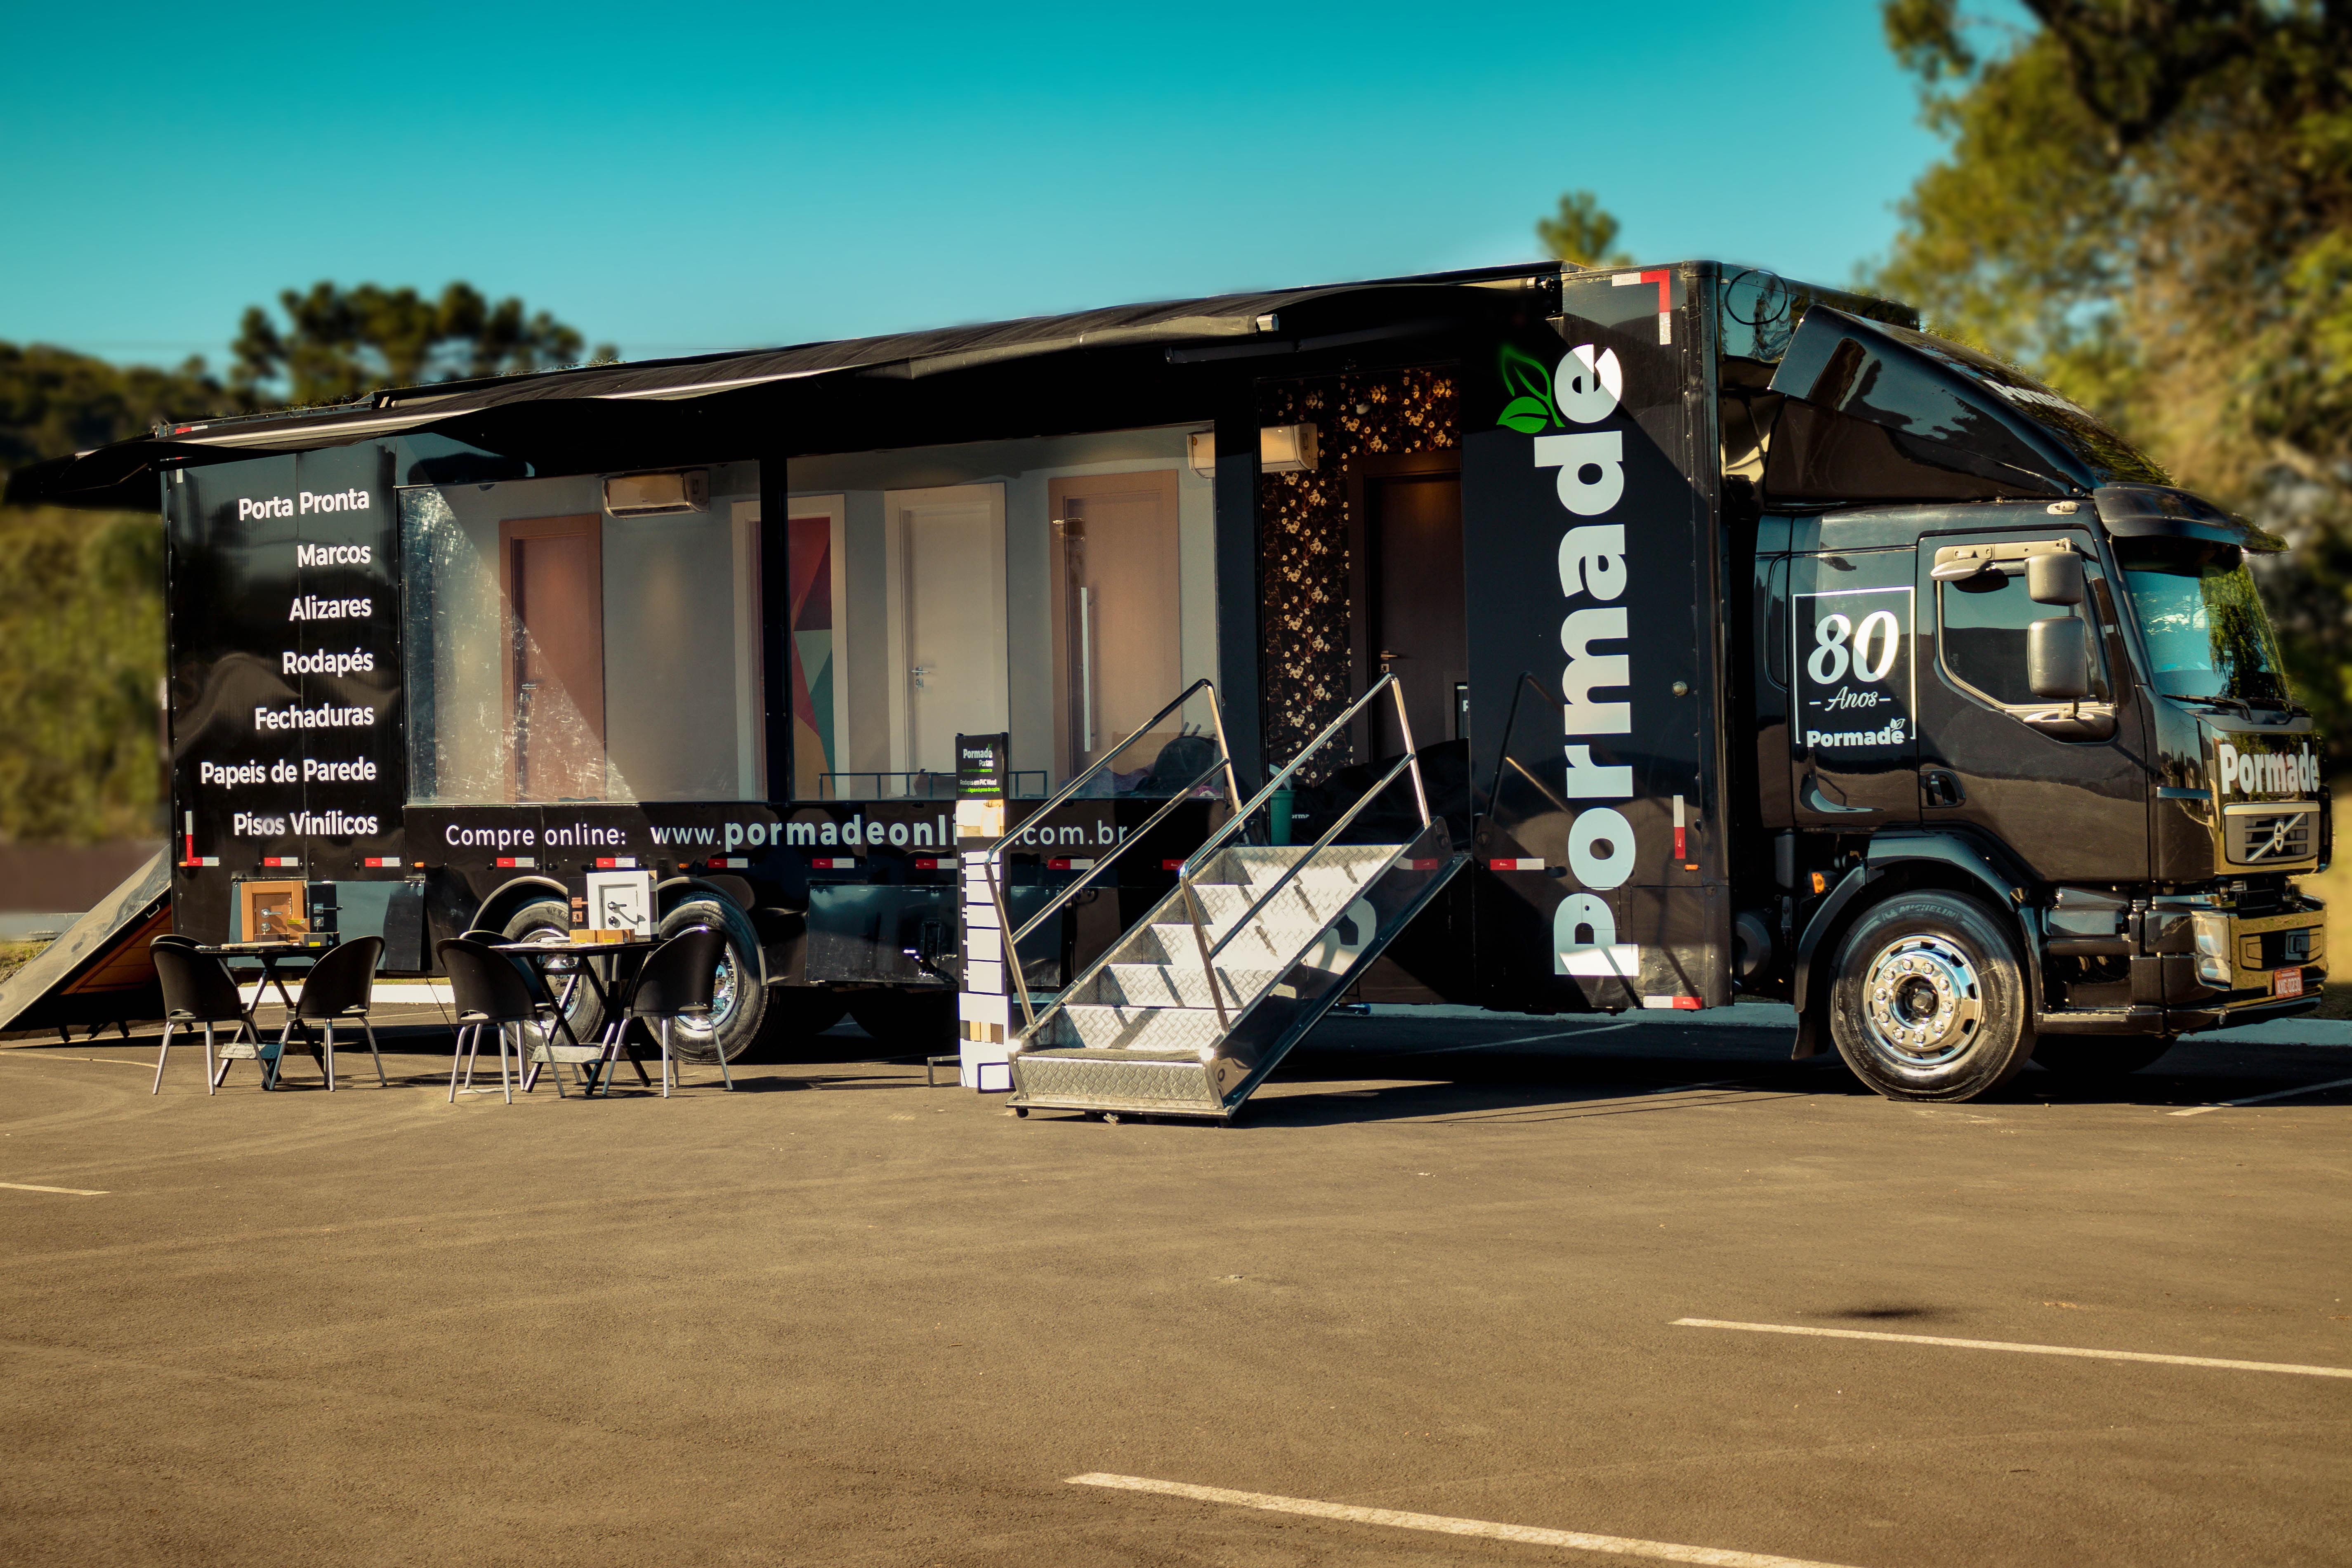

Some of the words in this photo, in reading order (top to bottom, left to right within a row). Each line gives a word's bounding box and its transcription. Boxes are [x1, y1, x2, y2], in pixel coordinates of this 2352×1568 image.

[238, 496, 293, 521] Porta
[300, 488, 369, 515] Pronta
[297, 544, 371, 568] Marcos
[289, 595, 372, 621] Alizares
[283, 647, 373, 678] Rodapés
[1534, 344, 1640, 976] Pormade
[1807, 610, 1899, 685] 80
[255, 703, 374, 730] Fechaduras
[1807, 726, 1905, 747] Pormade
[963, 747, 993, 759] Pormade
[2218, 742, 2319, 795] Pormade
[201, 759, 266, 789] Papeis
[271, 759, 297, 783] de
[303, 756, 377, 782] Parede
[234, 811, 285, 836] Pisos
[290, 810, 378, 835] Vinílicos
[446, 825, 534, 851] Compre
[545, 823, 626, 845] online:
[650, 814, 1128, 852] www.pormadeonli.com.br
